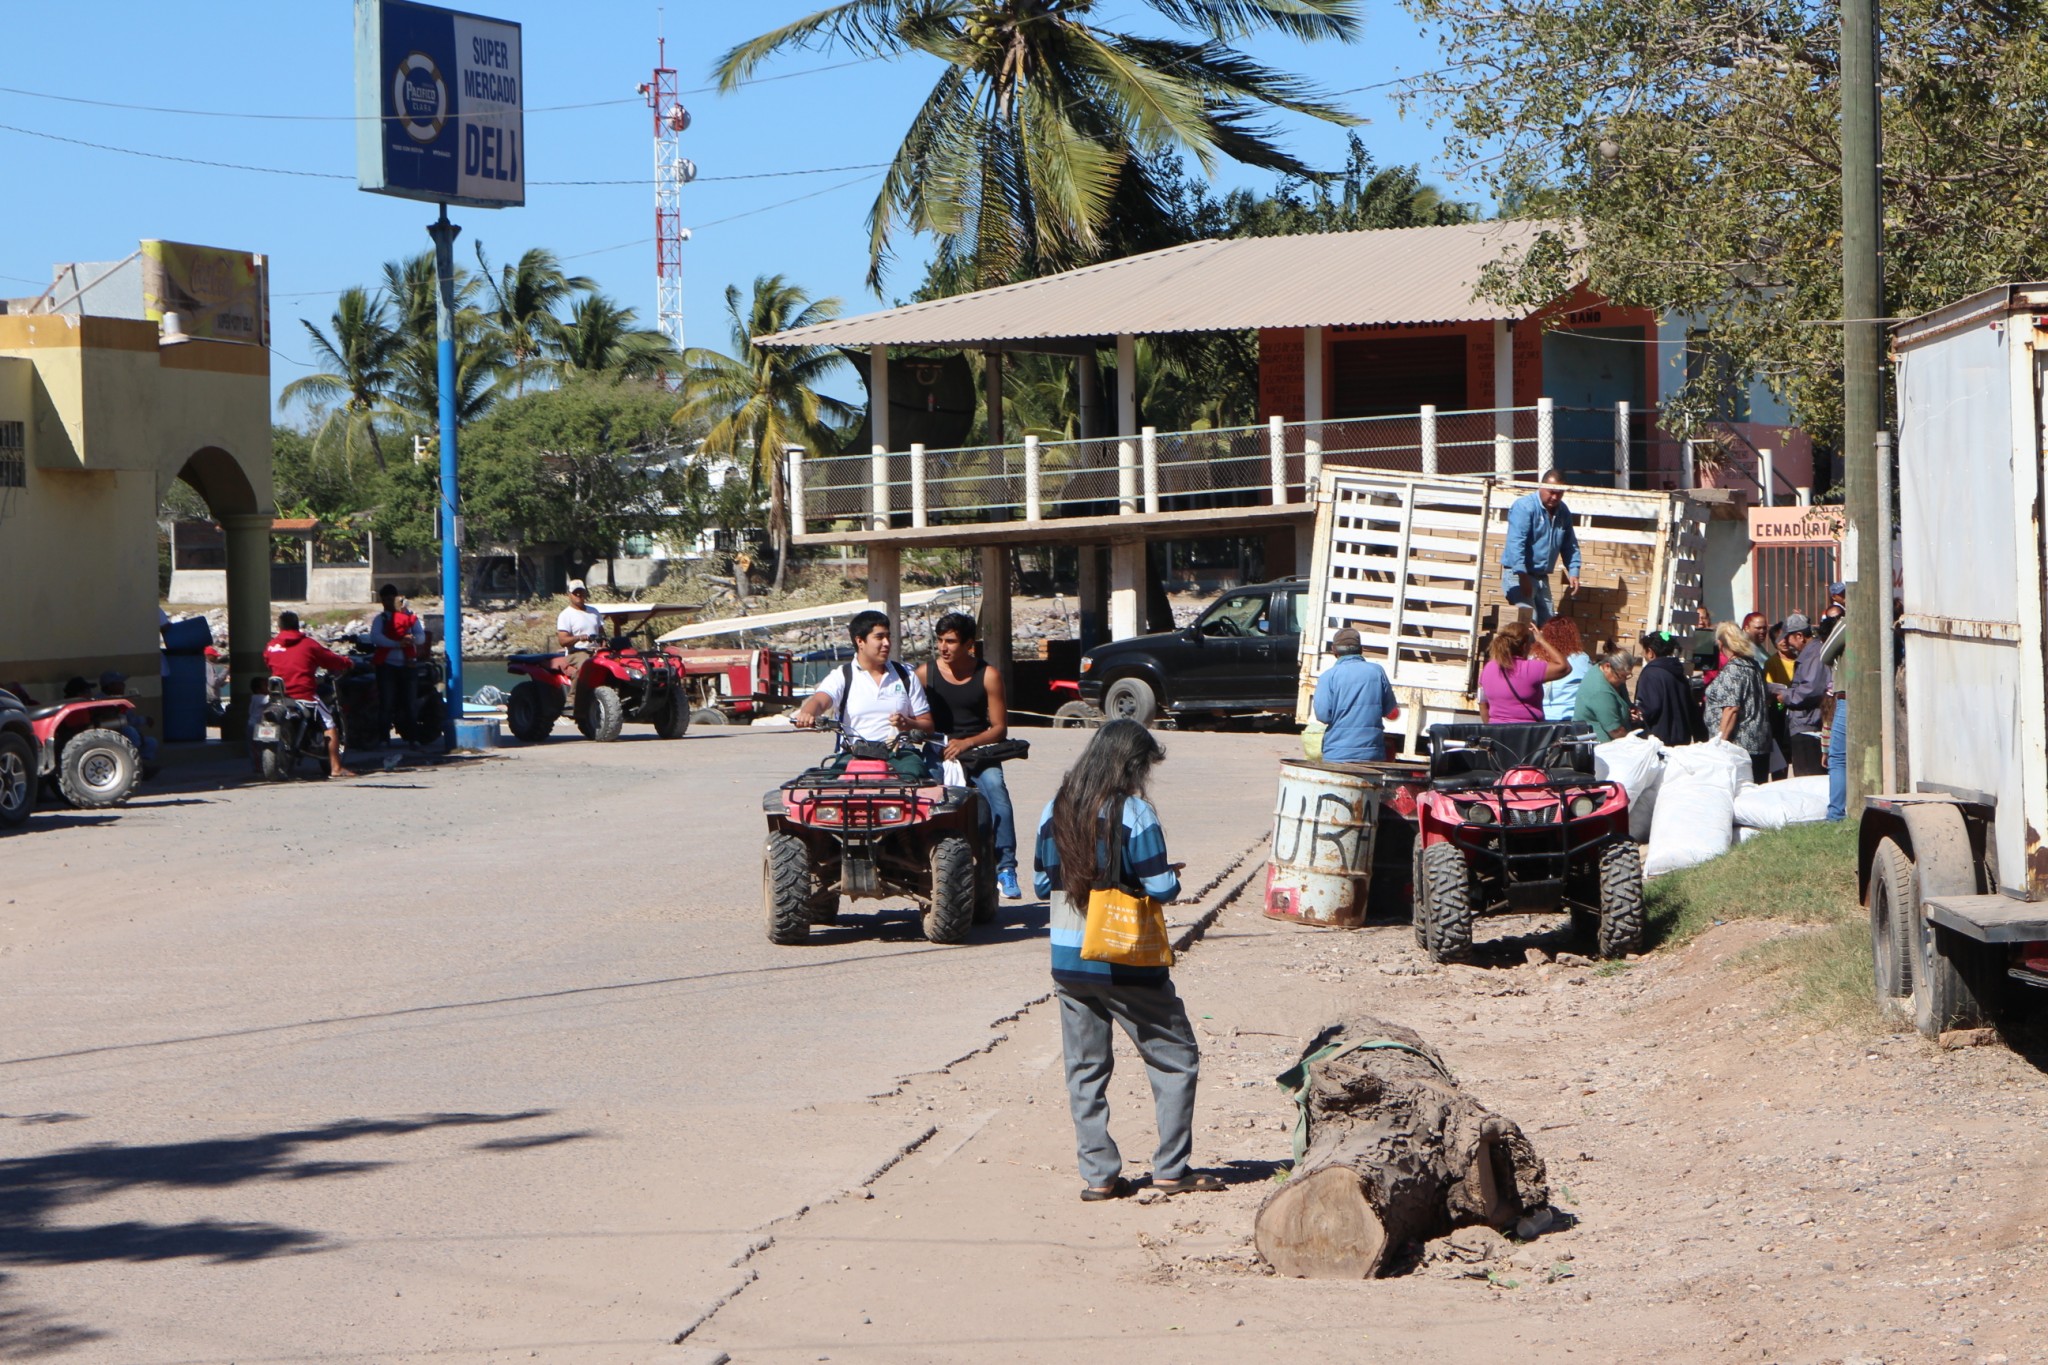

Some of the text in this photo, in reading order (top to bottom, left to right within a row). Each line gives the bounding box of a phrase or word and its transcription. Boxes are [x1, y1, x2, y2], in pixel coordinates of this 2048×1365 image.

[473, 36, 508, 70] SUPER
[464, 69, 516, 105] MERCADO
[465, 123, 517, 182] DELI
